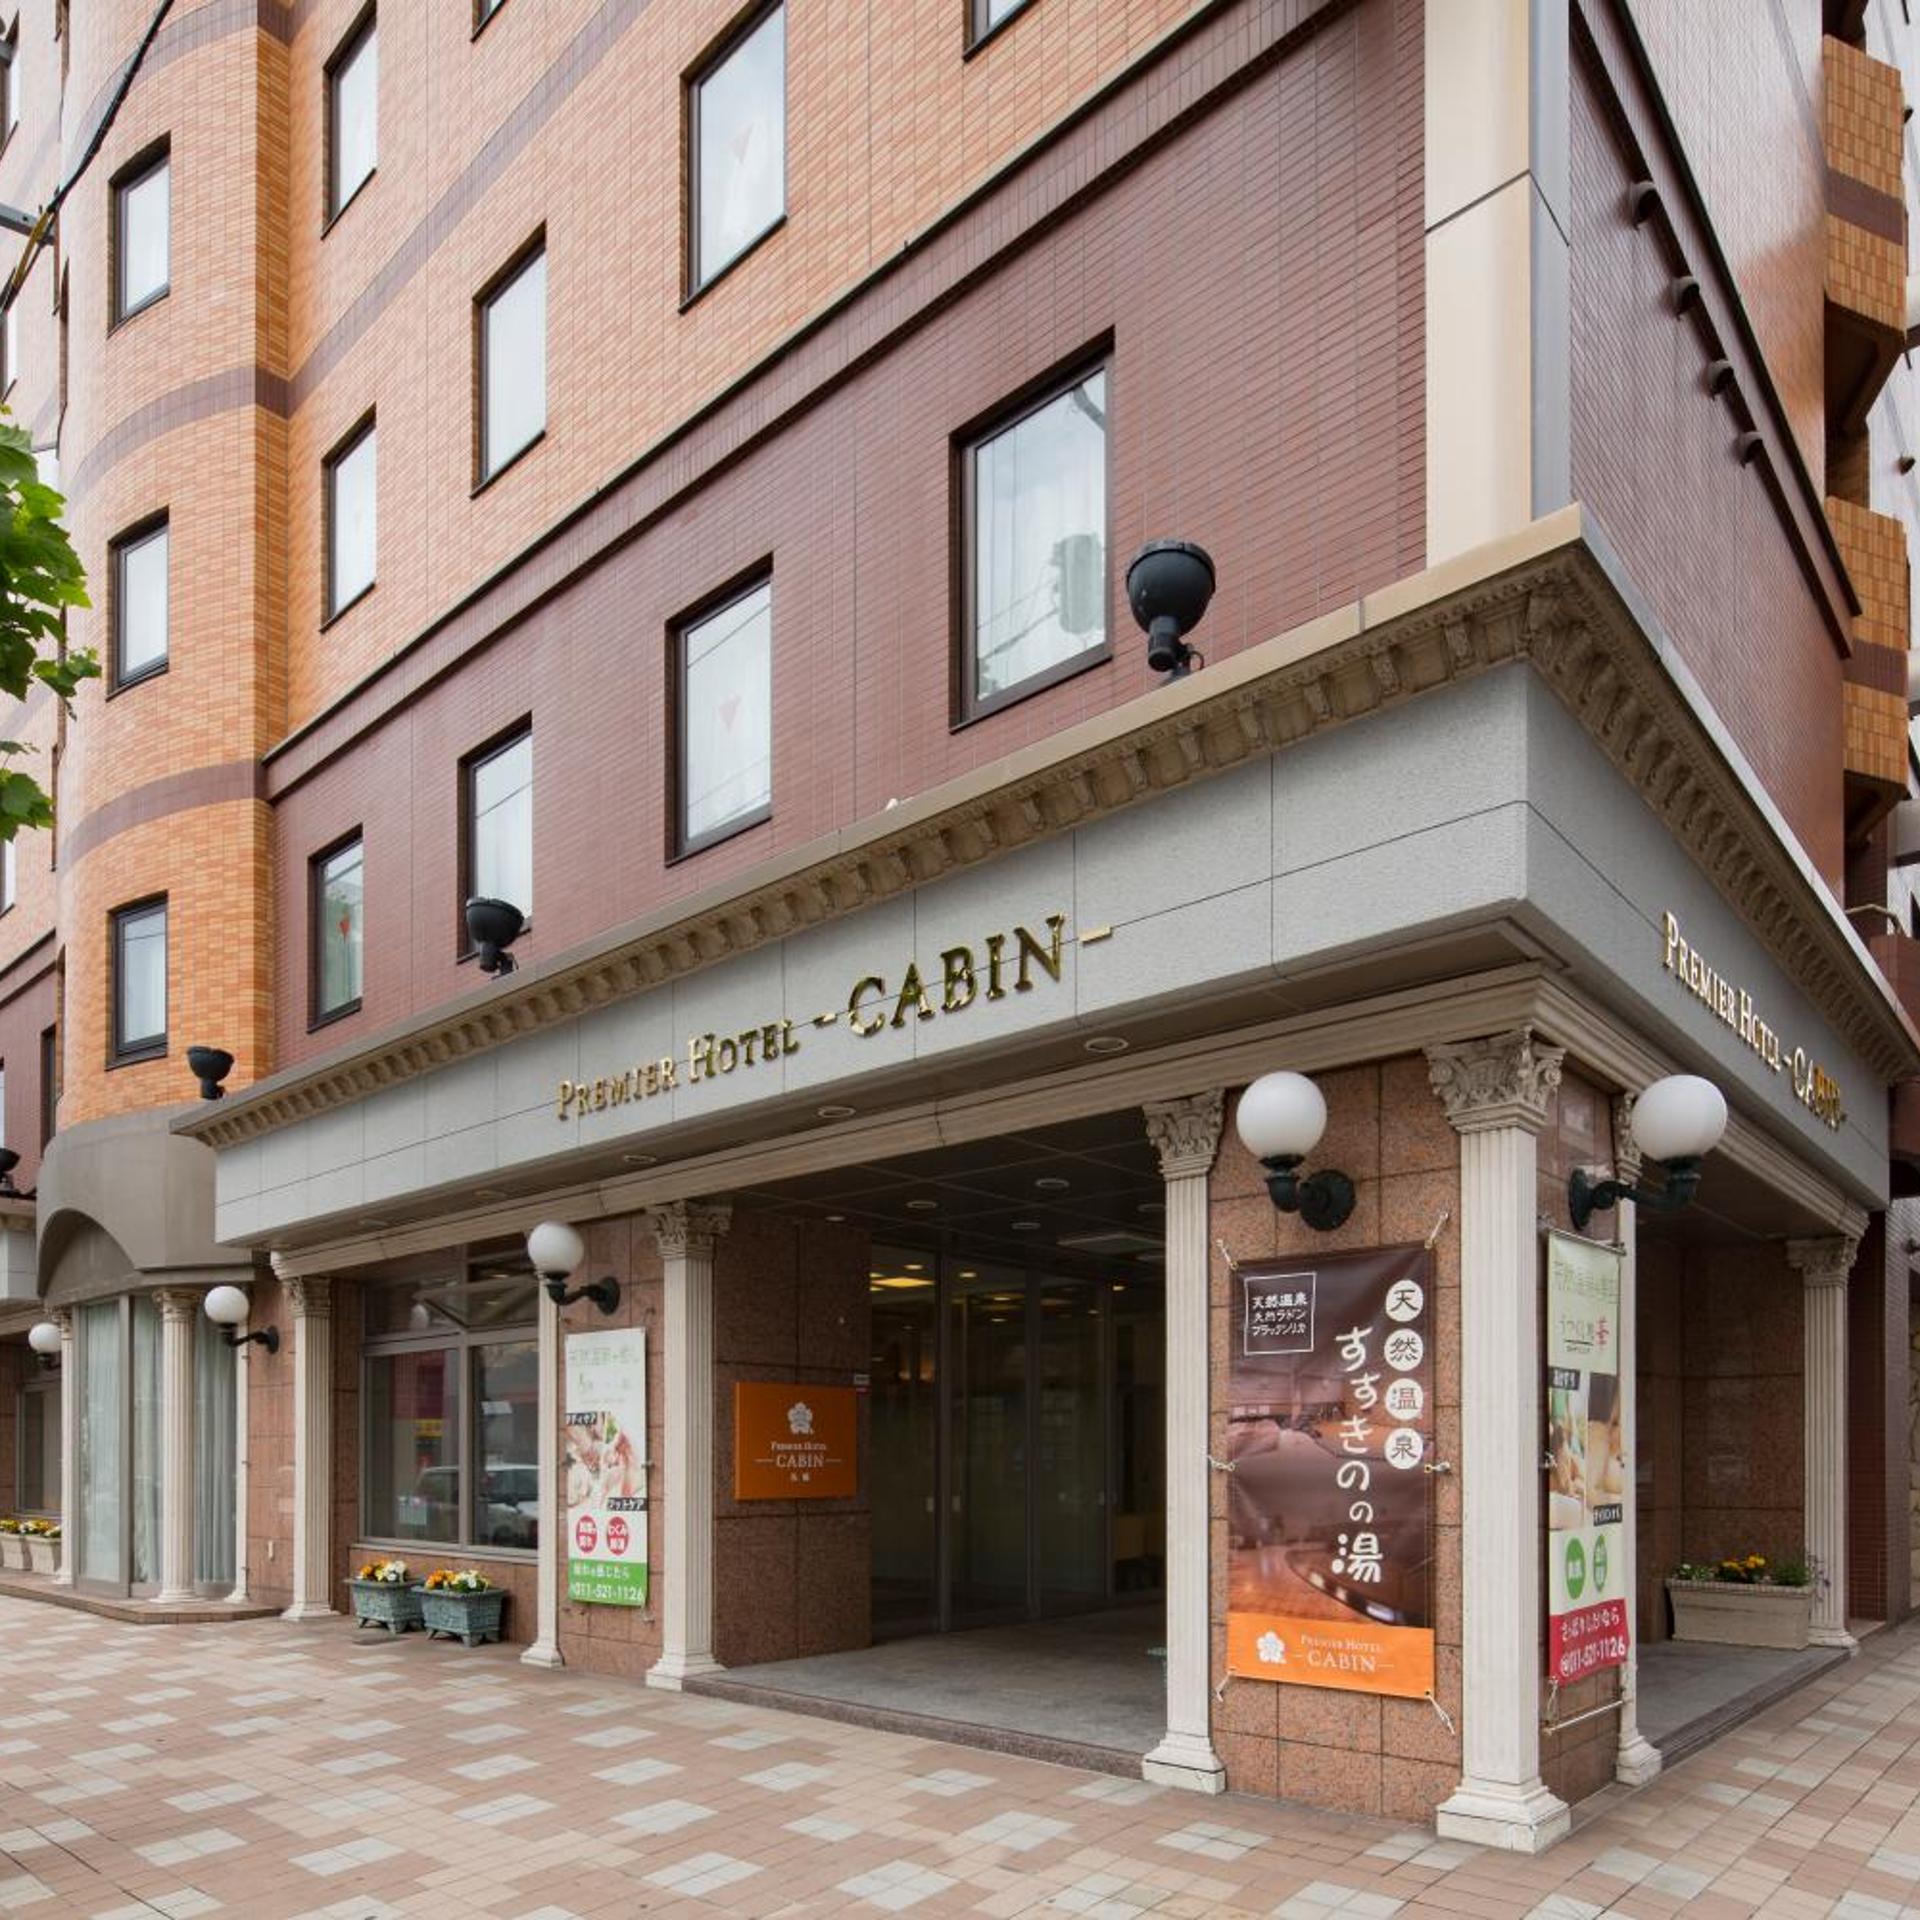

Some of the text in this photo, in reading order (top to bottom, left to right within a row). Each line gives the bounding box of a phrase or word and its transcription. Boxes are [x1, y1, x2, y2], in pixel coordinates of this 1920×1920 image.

[558, 1057, 679, 1120] PREMIER
[687, 1018, 800, 1083] HOTEL
[1389, 1285, 1421, 1462] 天然温泉
